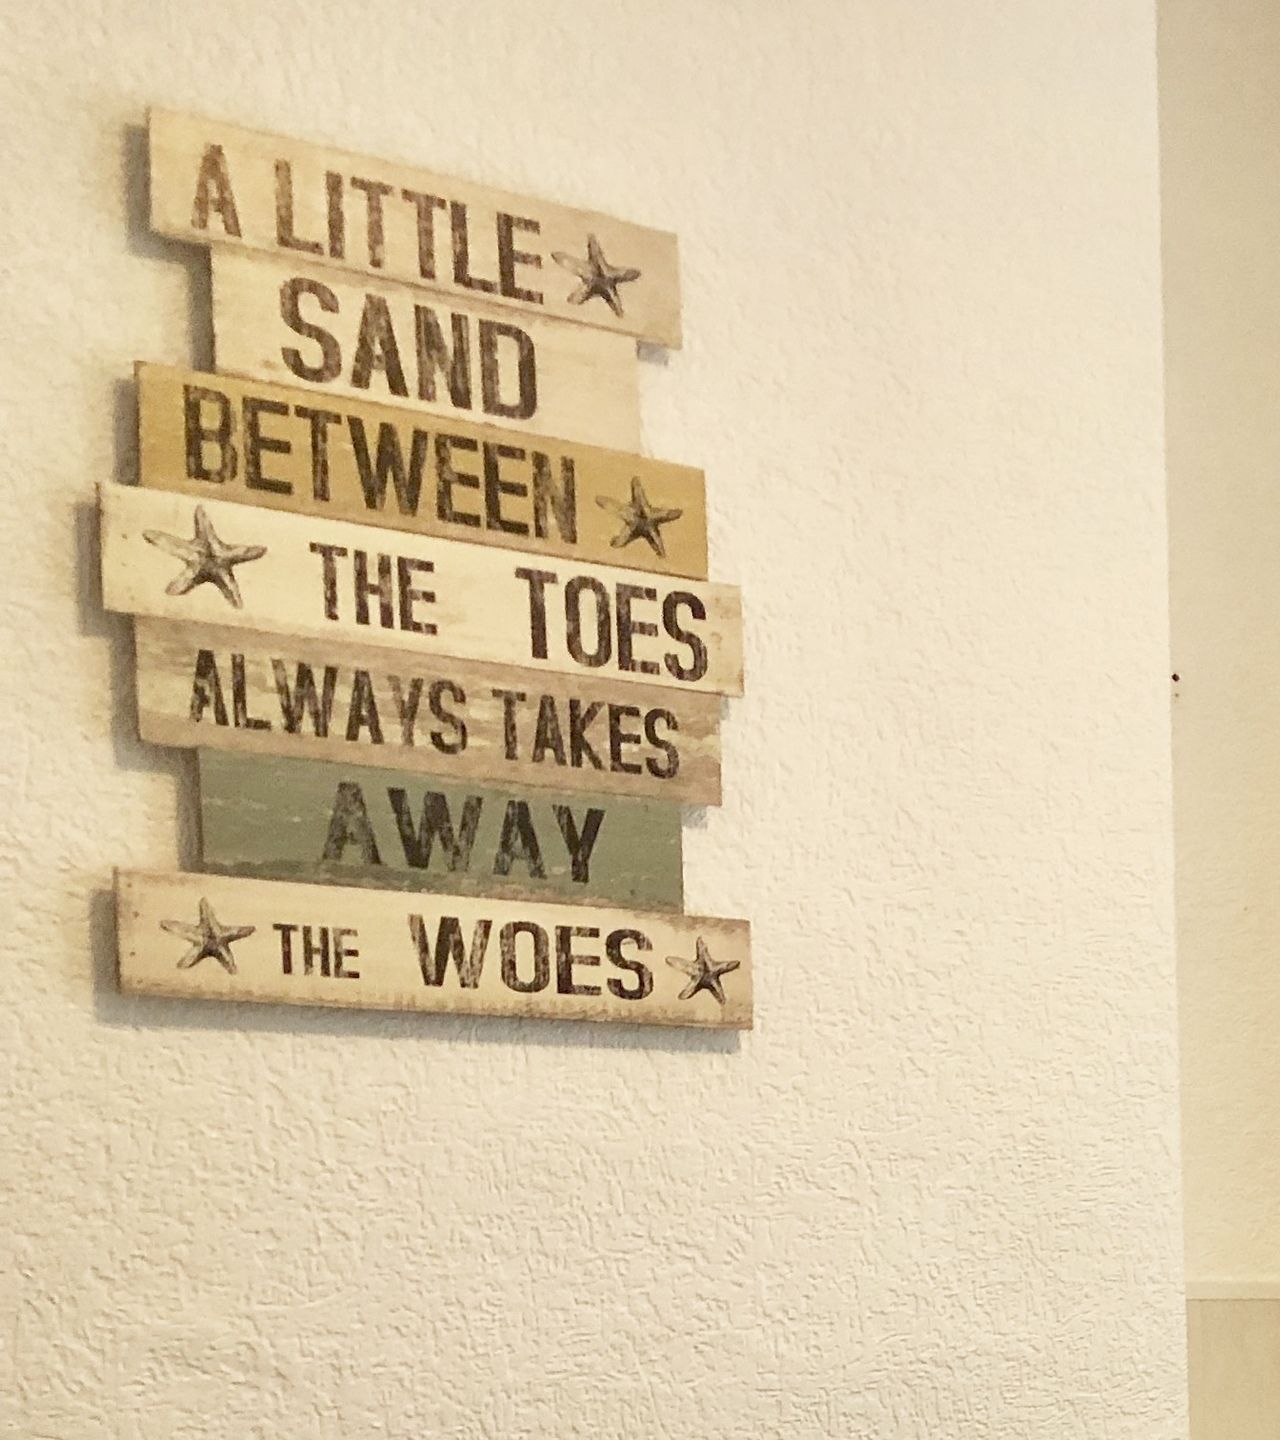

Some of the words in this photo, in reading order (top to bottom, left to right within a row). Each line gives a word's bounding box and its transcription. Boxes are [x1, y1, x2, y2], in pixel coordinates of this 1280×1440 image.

[190, 144, 243, 238] A
[275, 159, 544, 305] LITTLE
[279, 277, 538, 420] SAND
[183, 384, 578, 544] BETWEEN
[309, 542, 440, 635] THE
[514, 567, 709, 682] TOES
[189, 649, 468, 755] ALWAYS
[491, 688, 681, 779] TAKES
[320, 781, 606, 884] AWAY
[272, 923, 361, 980] THE
[408, 913, 655, 1001] WOES
